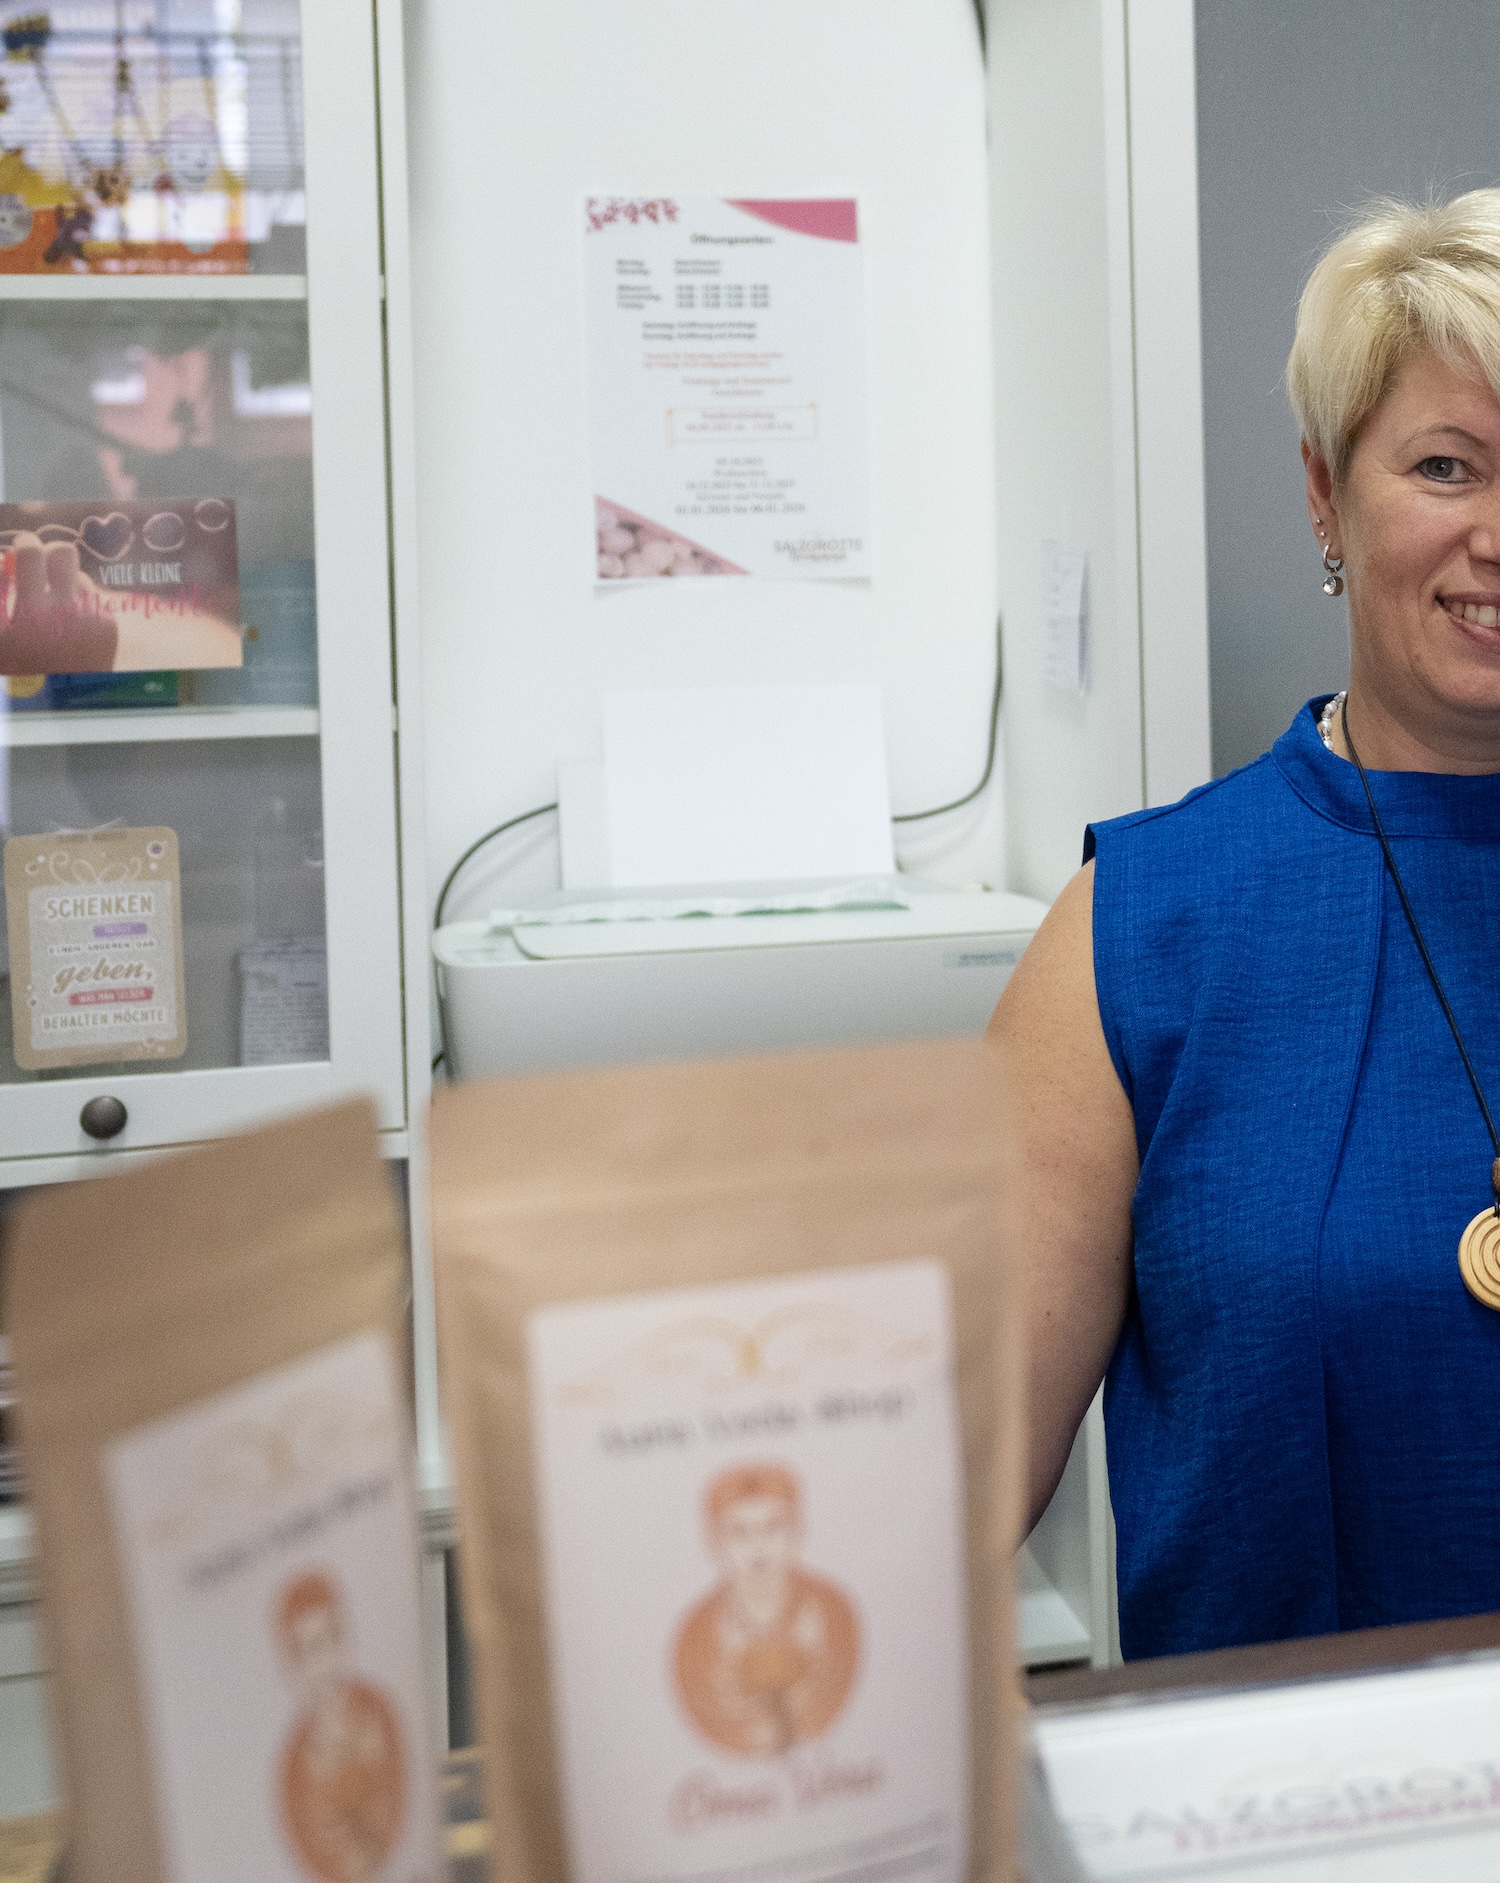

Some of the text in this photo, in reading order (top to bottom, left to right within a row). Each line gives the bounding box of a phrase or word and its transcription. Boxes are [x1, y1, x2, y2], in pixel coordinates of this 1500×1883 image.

[100, 561, 182, 586] VIELE KLEINE
[47, 894, 153, 919] SCHENKEN
[52, 957, 153, 994] geben,
[43, 1008, 164, 1030] BEHALTEN MÖCHTE
